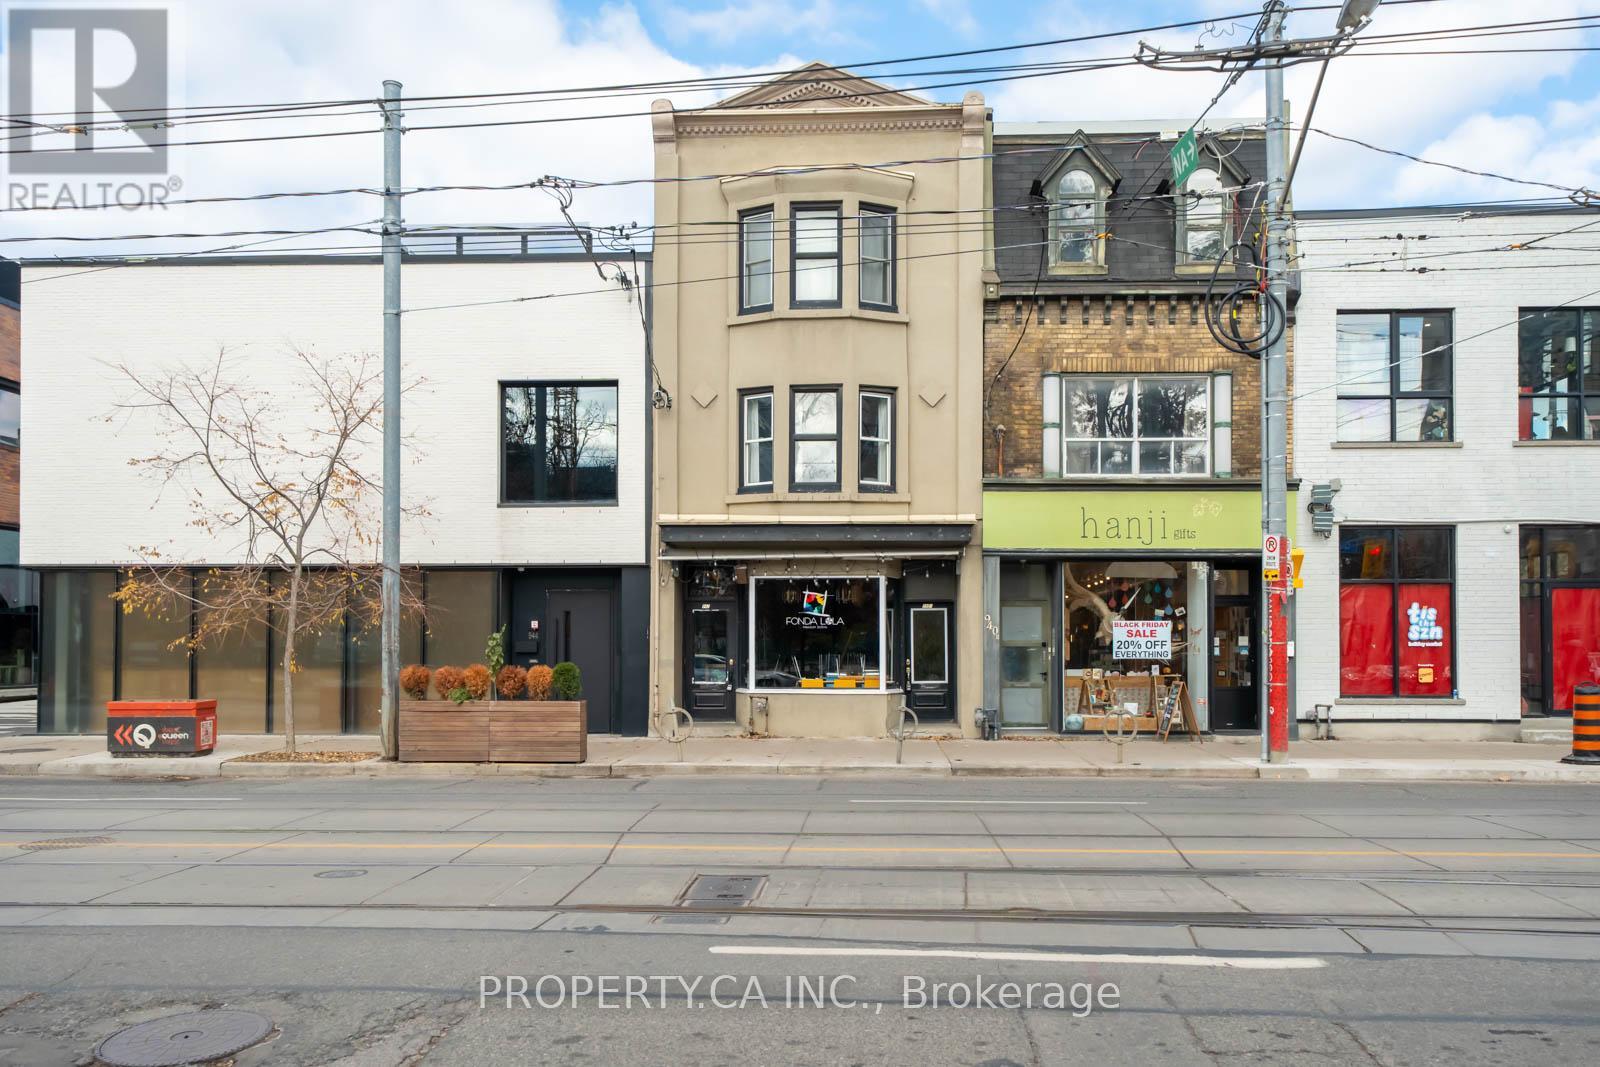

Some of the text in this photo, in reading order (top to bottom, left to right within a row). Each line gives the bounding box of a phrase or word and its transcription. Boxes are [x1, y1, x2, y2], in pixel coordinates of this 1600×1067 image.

[1080, 506, 1197, 546] hanji gifts
[785, 616, 845, 626] FONDA LOLA
[1126, 629, 1157, 638] SALE
[1116, 640, 1167, 650] 20% OFF
[1115, 650, 1169, 658] EVERYTHING
